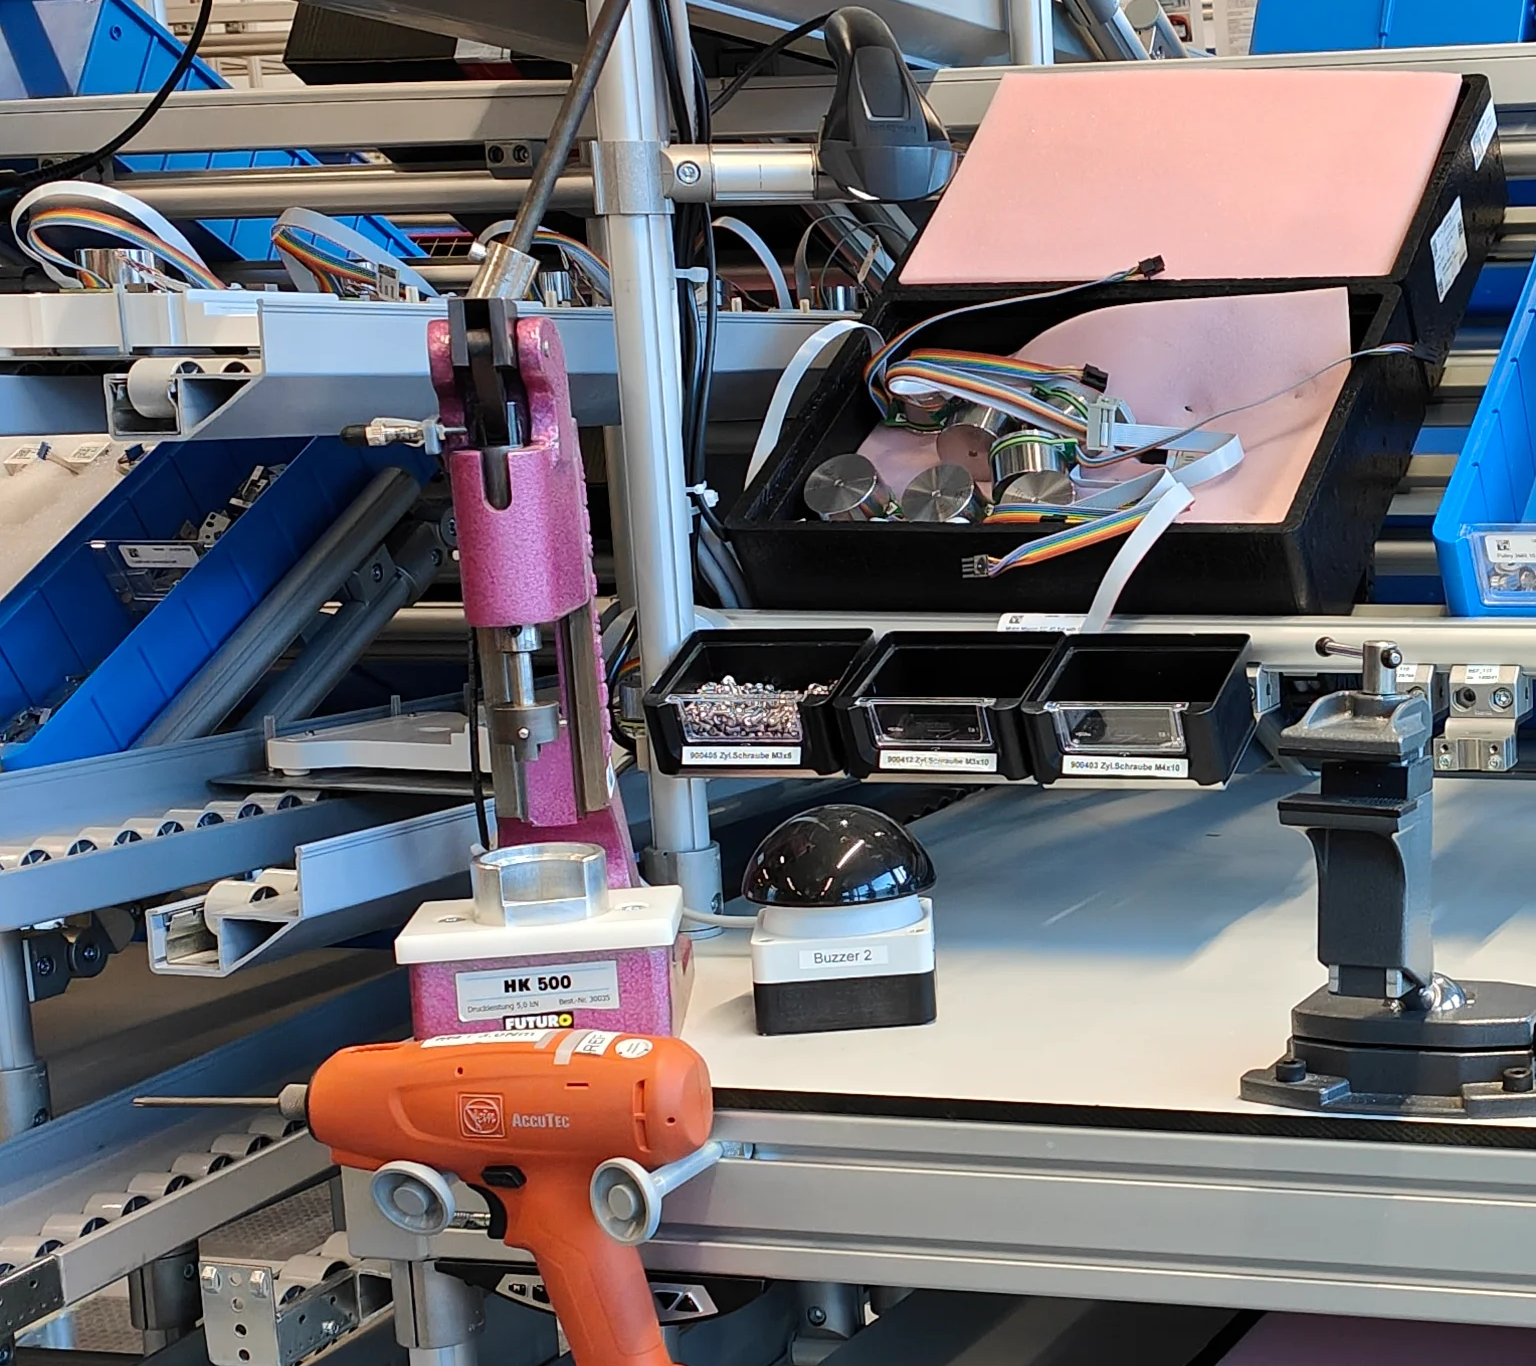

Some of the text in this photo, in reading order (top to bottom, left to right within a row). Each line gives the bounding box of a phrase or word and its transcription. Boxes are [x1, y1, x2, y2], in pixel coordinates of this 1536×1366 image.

[719, 750, 770, 761] Zyl.Schraube
[1100, 760, 1153, 773] Zyl.Schraube
[813, 948, 873, 965] Buzzer 2
[504, 975, 572, 993] HK 500
[467, 1003, 515, 1014] Druckleistung
[505, 1013, 573, 1030] FUTURO
